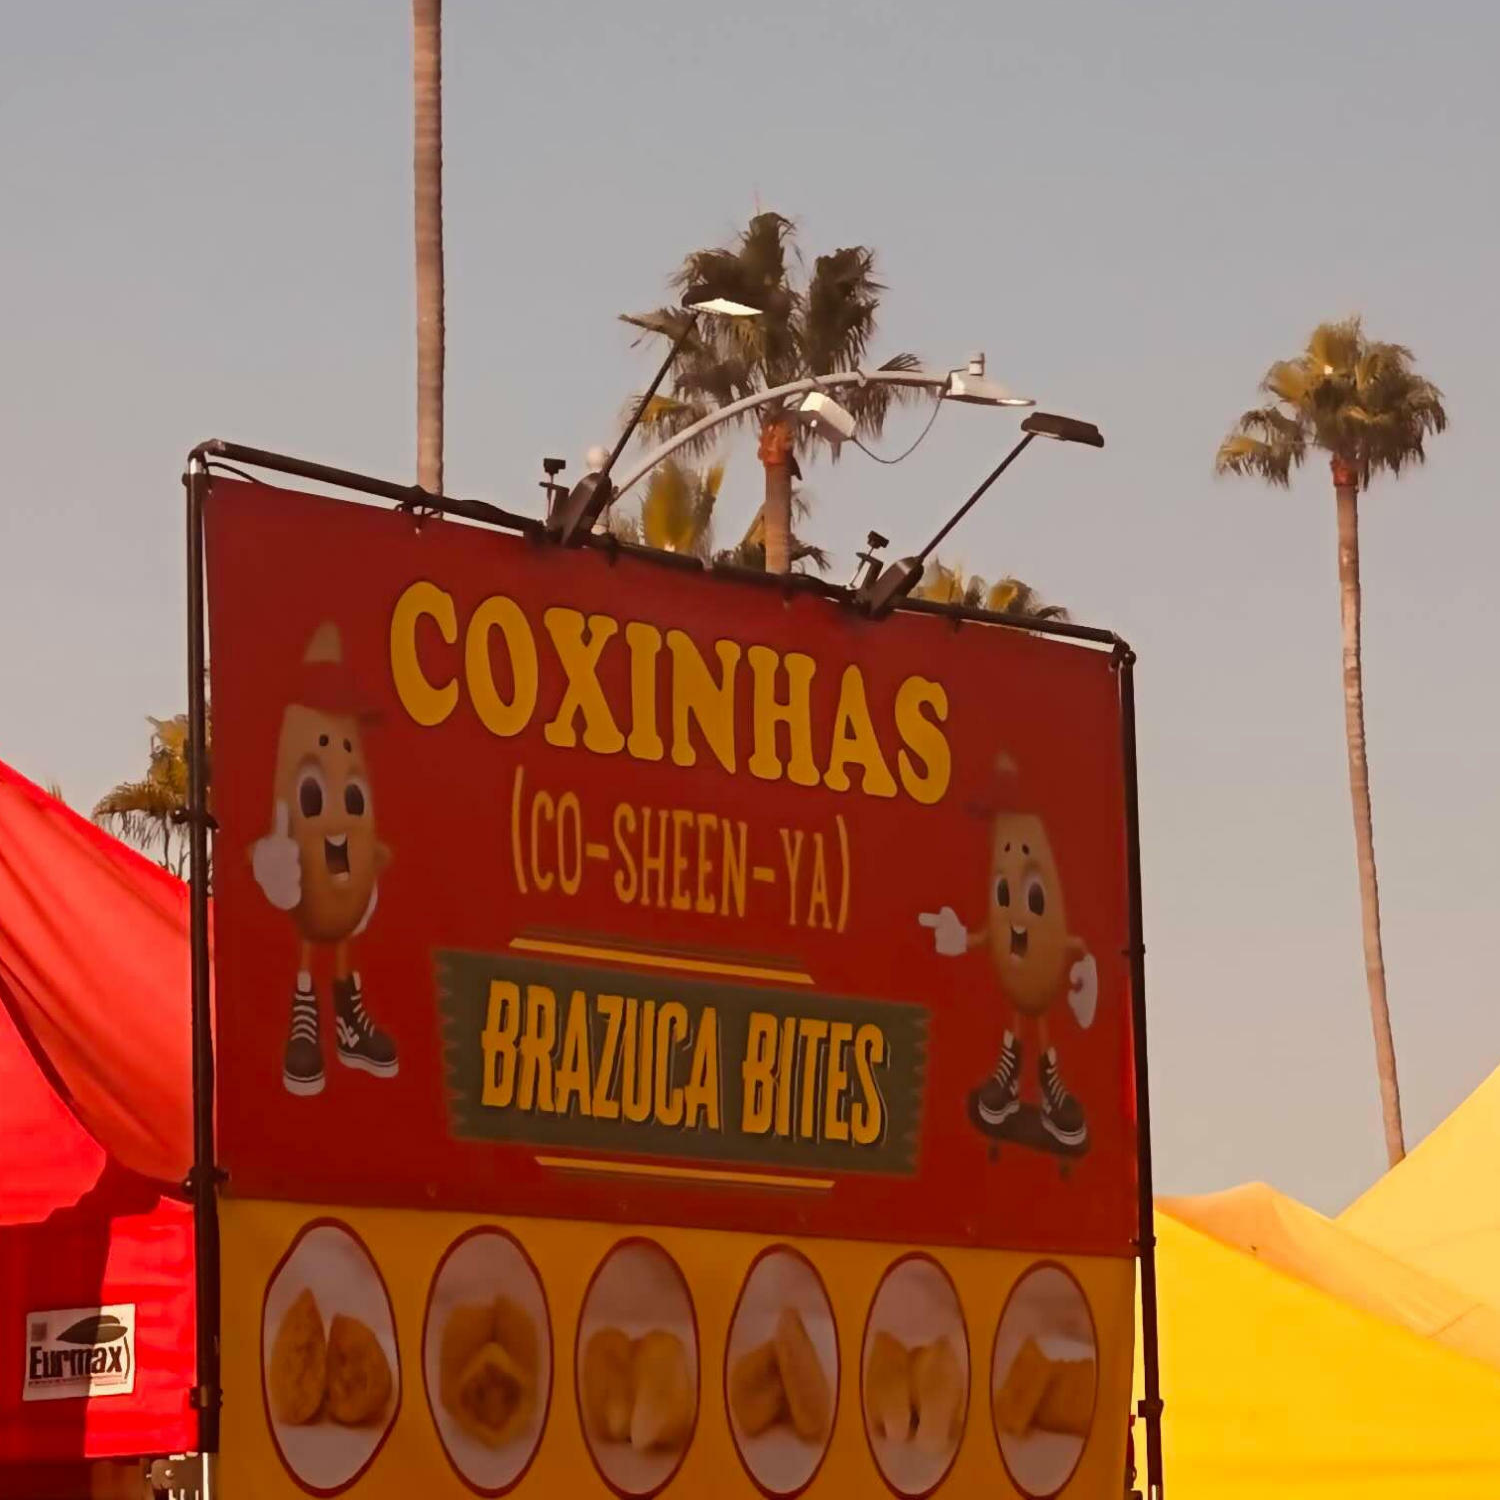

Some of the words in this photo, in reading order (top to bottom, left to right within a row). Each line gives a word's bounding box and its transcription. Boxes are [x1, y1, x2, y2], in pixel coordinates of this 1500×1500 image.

[389, 581, 952, 805] COXINHAS
[511, 765, 851, 934] (CO-SHEEN-YA)
[479, 979, 722, 1132] BRAZUCA
[742, 1010, 888, 1146] BITES
[29, 1345, 123, 1379] Eurmax
